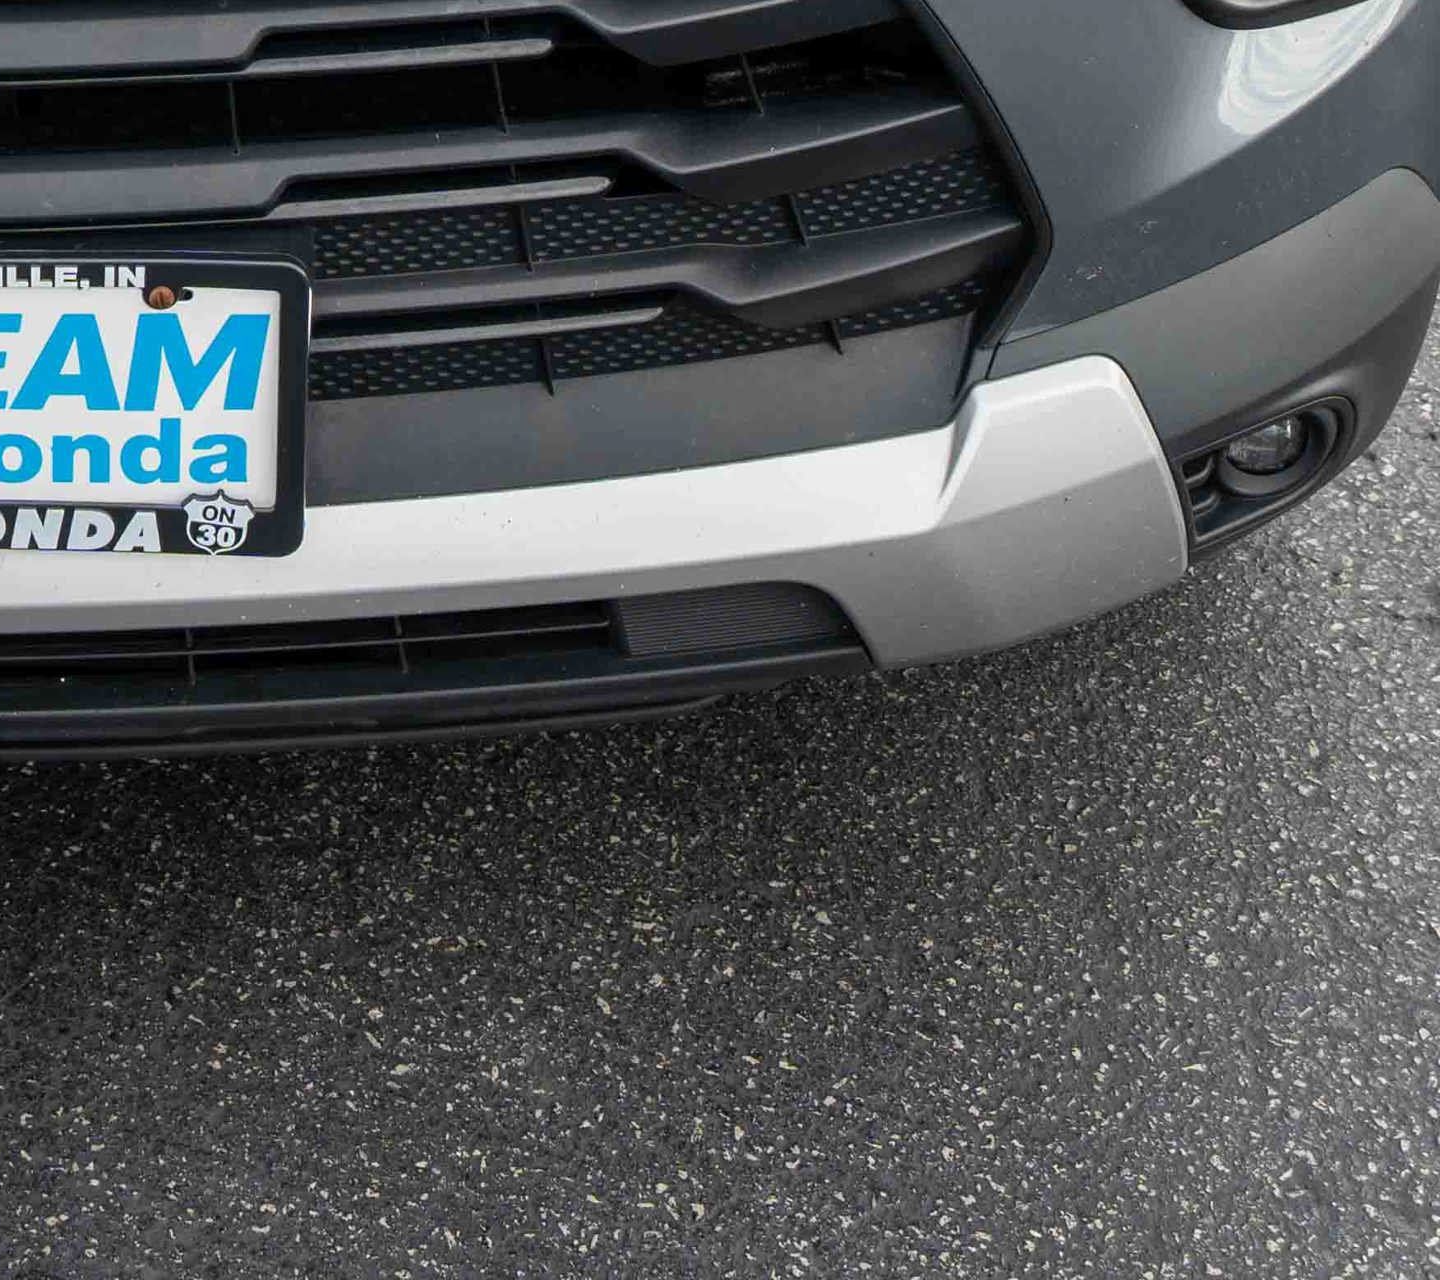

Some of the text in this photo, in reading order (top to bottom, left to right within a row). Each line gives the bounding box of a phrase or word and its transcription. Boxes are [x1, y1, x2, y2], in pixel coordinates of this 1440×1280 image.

[104, 266, 145, 288] IN
[202, 505, 236, 525] ON
[196, 524, 236, 548] 30
